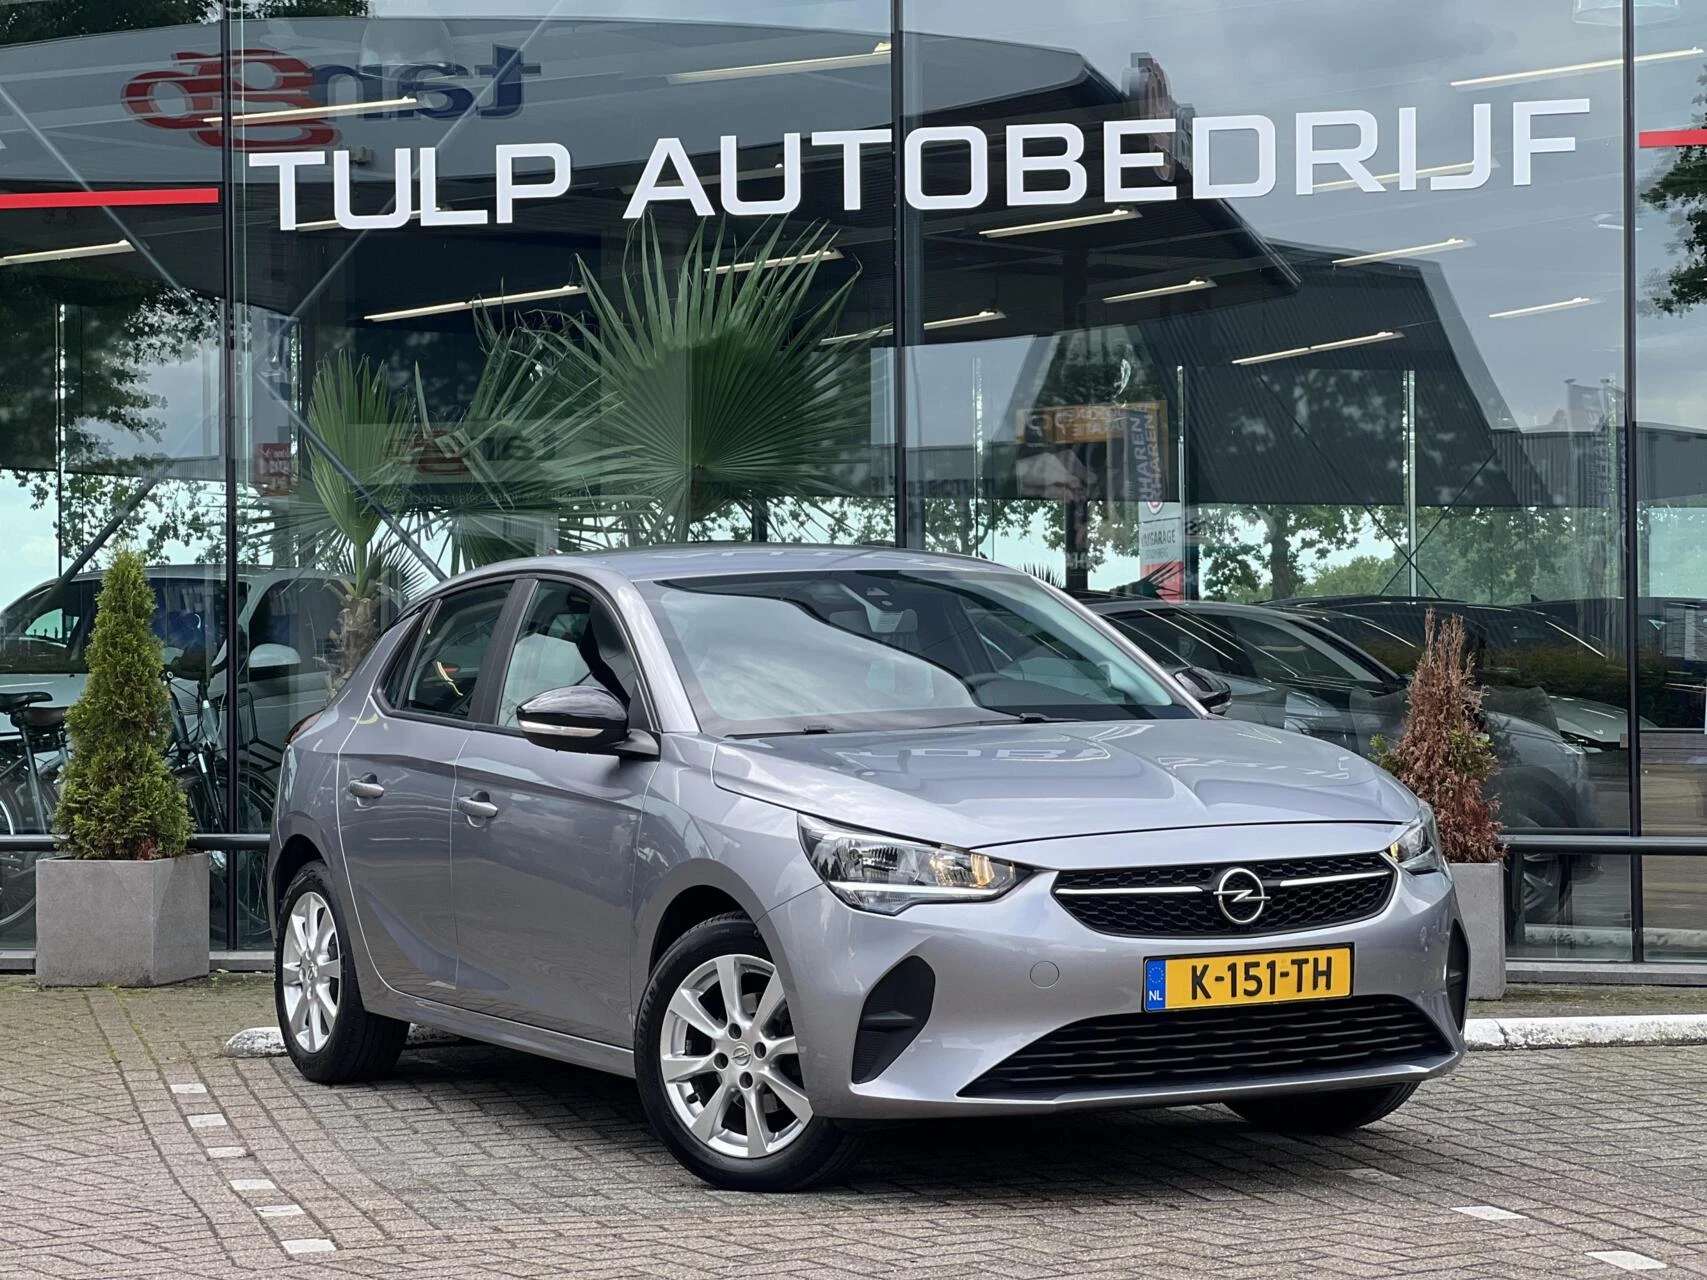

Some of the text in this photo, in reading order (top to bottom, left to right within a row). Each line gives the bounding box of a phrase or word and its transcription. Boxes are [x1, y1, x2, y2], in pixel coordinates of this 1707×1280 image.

[248, 142, 571, 230] TULP
[622, 98, 1591, 219] AUTOBEDRIJF
[1148, 956, 1333, 1002] NL K-151-TH
